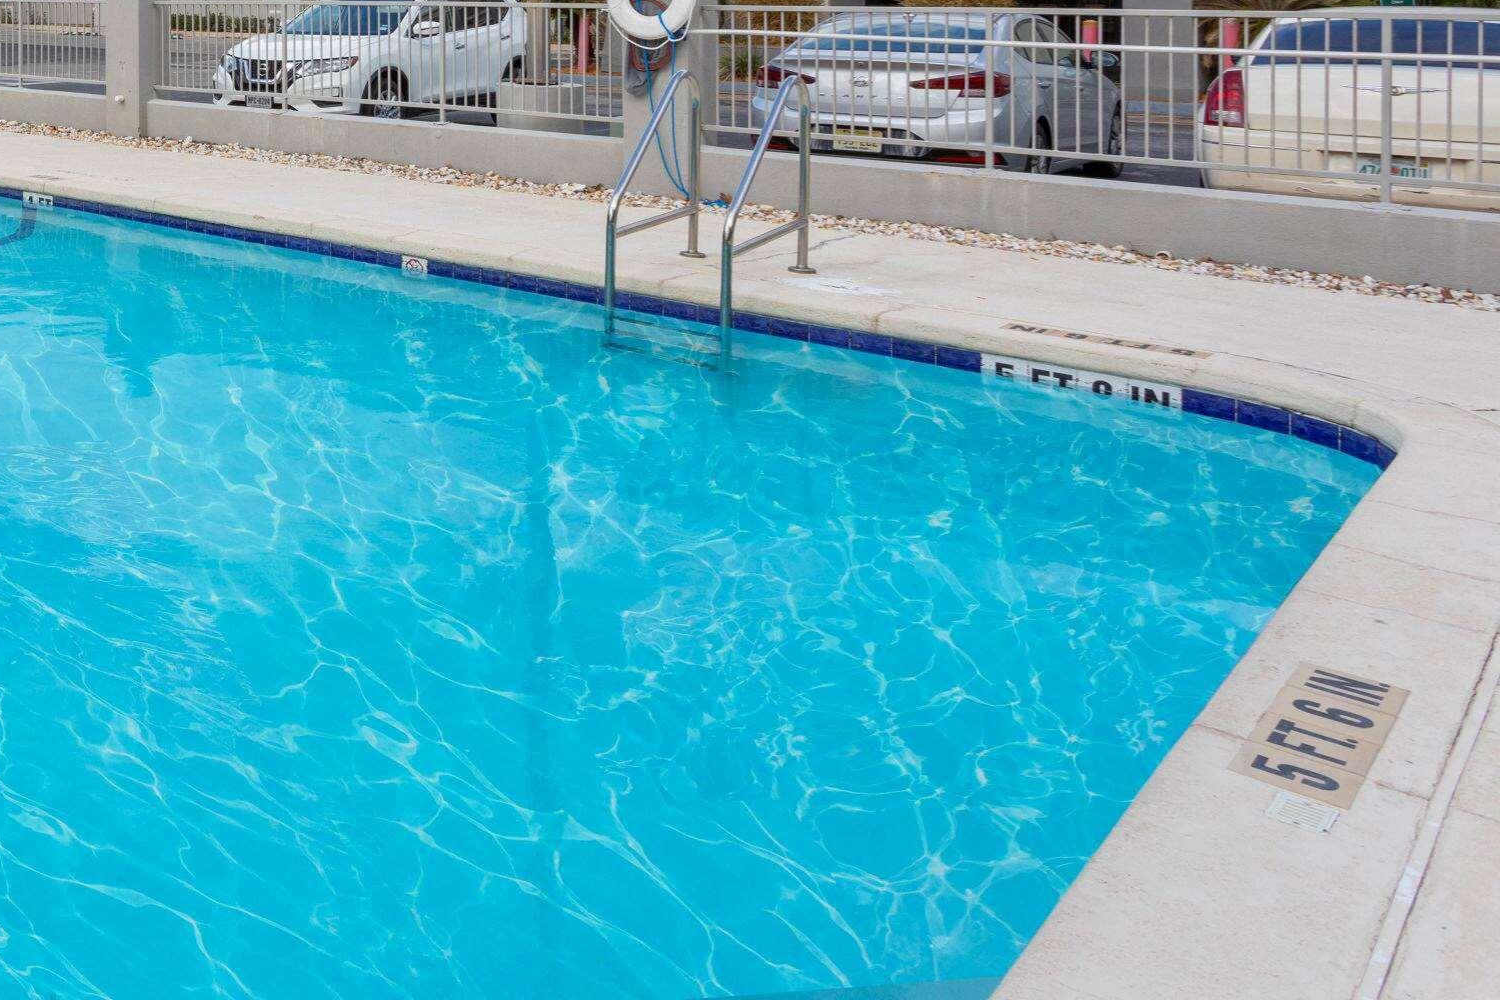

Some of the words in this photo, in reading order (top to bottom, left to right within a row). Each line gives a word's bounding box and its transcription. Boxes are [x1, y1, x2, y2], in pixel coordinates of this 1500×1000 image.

[1131, 385, 1170, 407] IN
[1293, 698, 1374, 729] 6
[1251, 754, 1340, 792] 5
